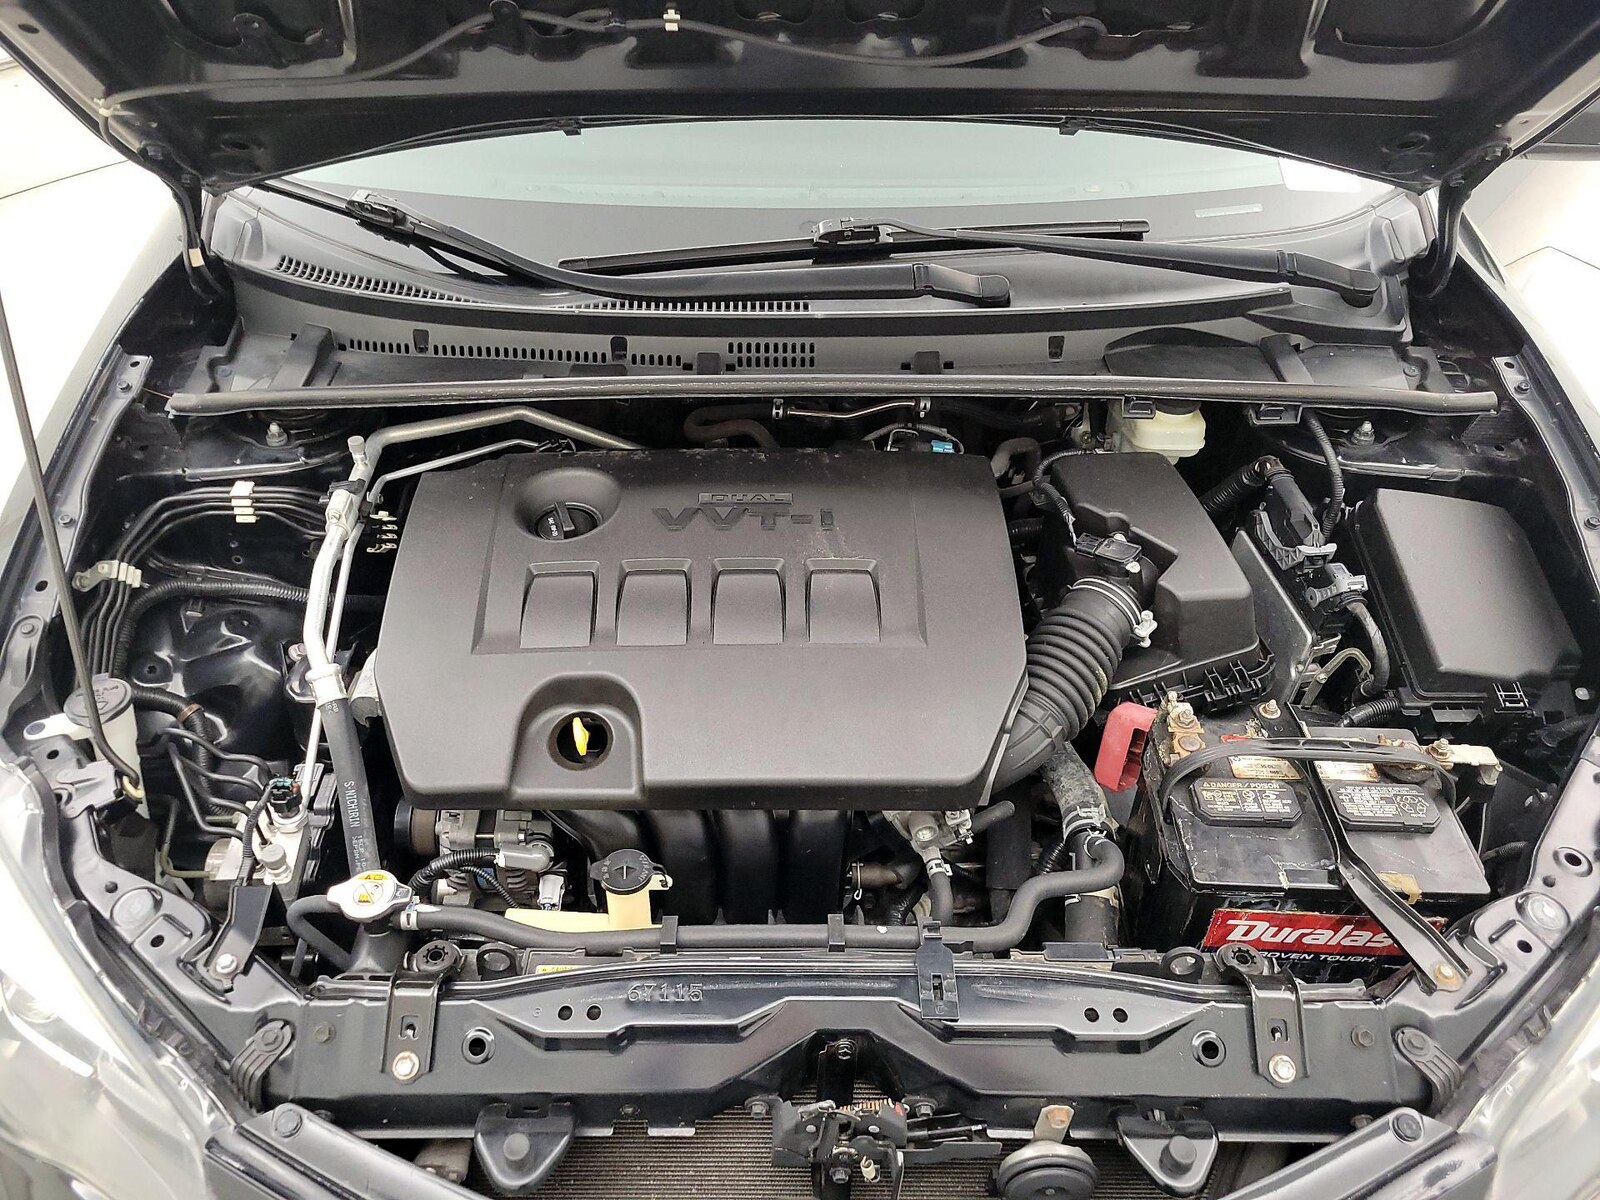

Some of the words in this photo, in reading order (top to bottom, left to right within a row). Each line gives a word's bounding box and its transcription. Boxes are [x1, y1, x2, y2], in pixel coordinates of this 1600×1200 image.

[708, 492, 788, 504] DUAL
[1226, 919, 1398, 948] Duralas
[1259, 951, 1315, 960] ROVEN
[1319, 954, 1375, 963] TOUGH
[627, 983, 703, 1002] 67115
